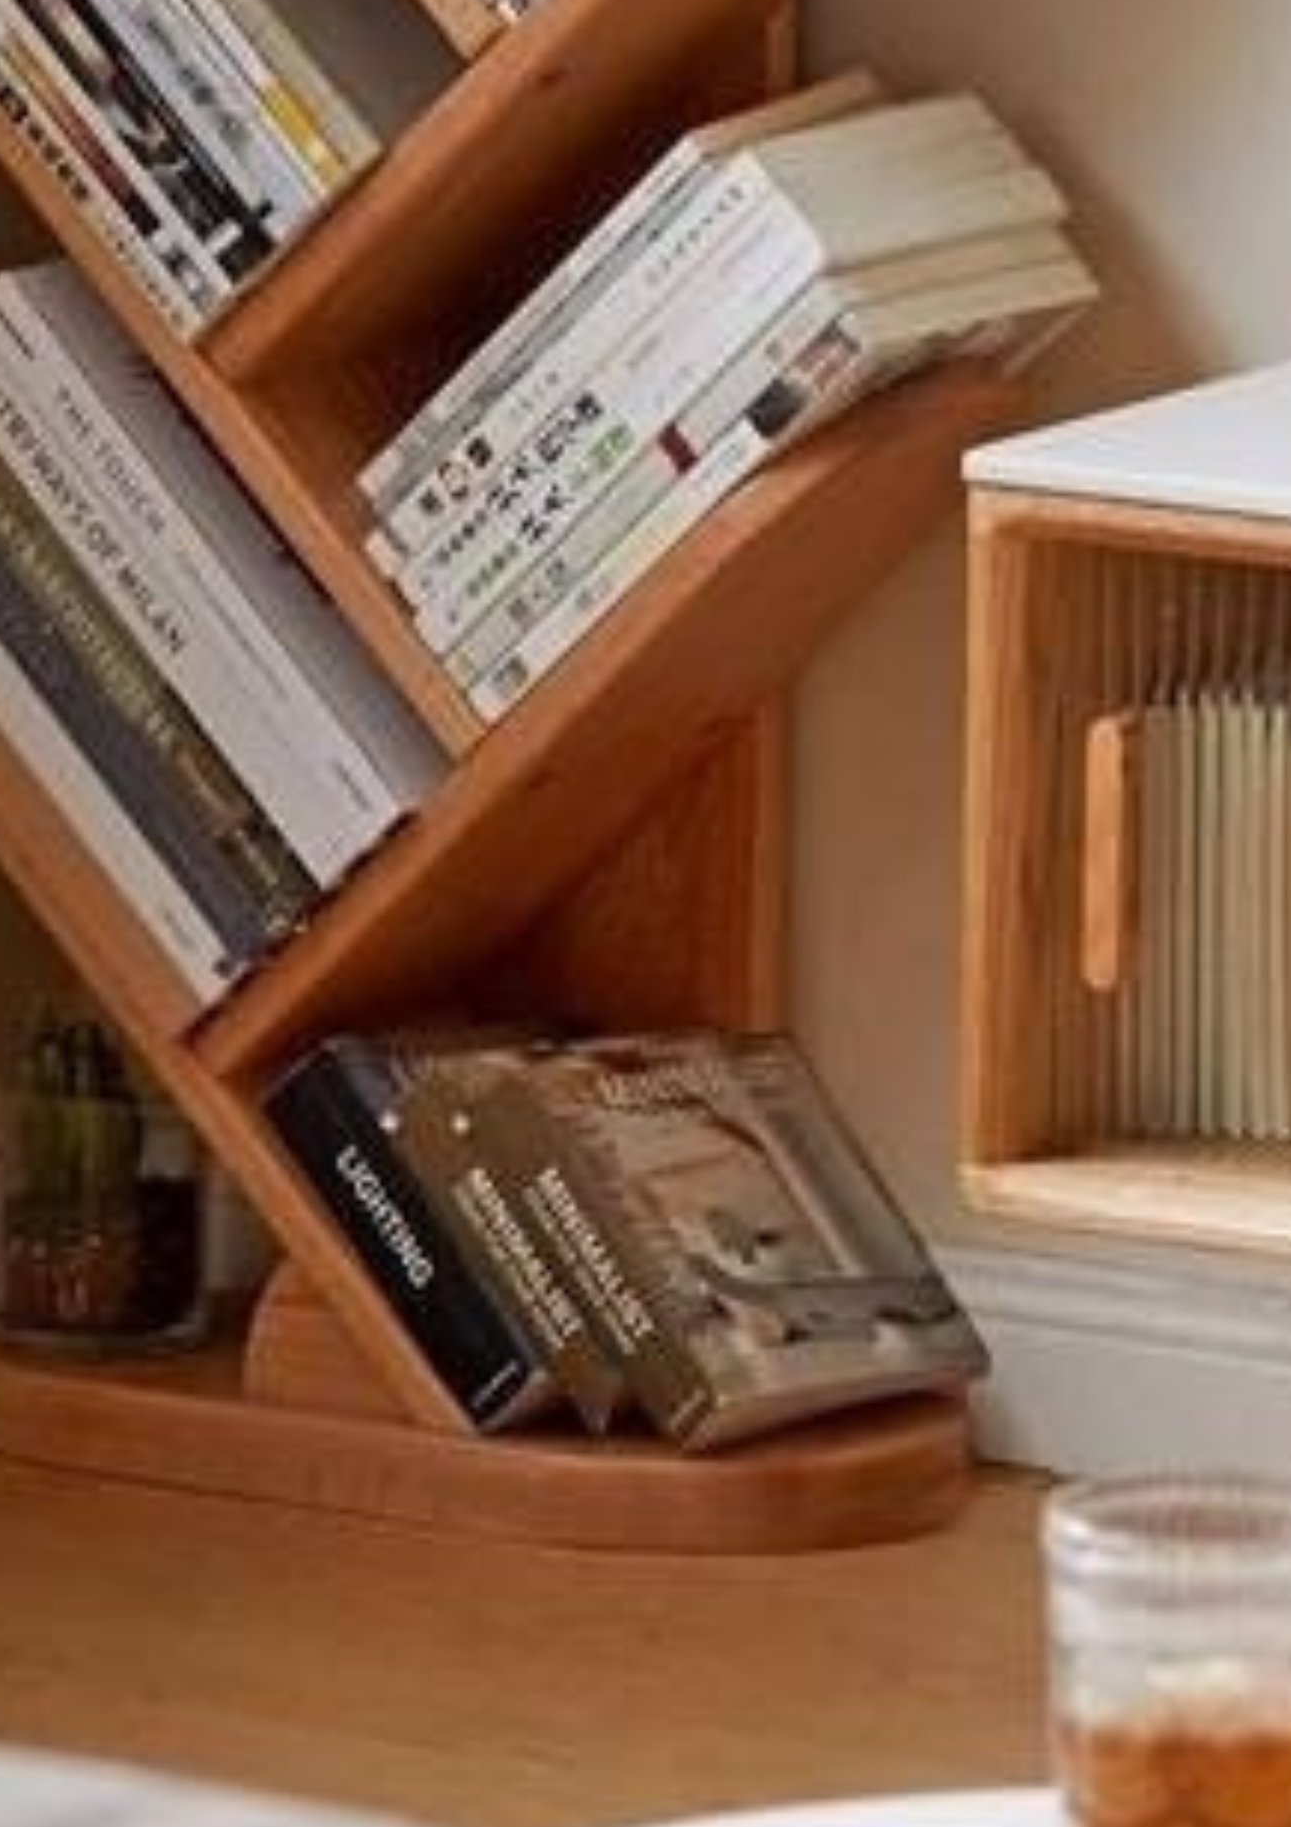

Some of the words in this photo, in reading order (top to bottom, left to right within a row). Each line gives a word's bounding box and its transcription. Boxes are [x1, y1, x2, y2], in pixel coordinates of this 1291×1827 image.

[86, 519, 120, 565] OF
[115, 566, 187, 656] MILAN
[335, 1143, 435, 1291] LIGHTING
